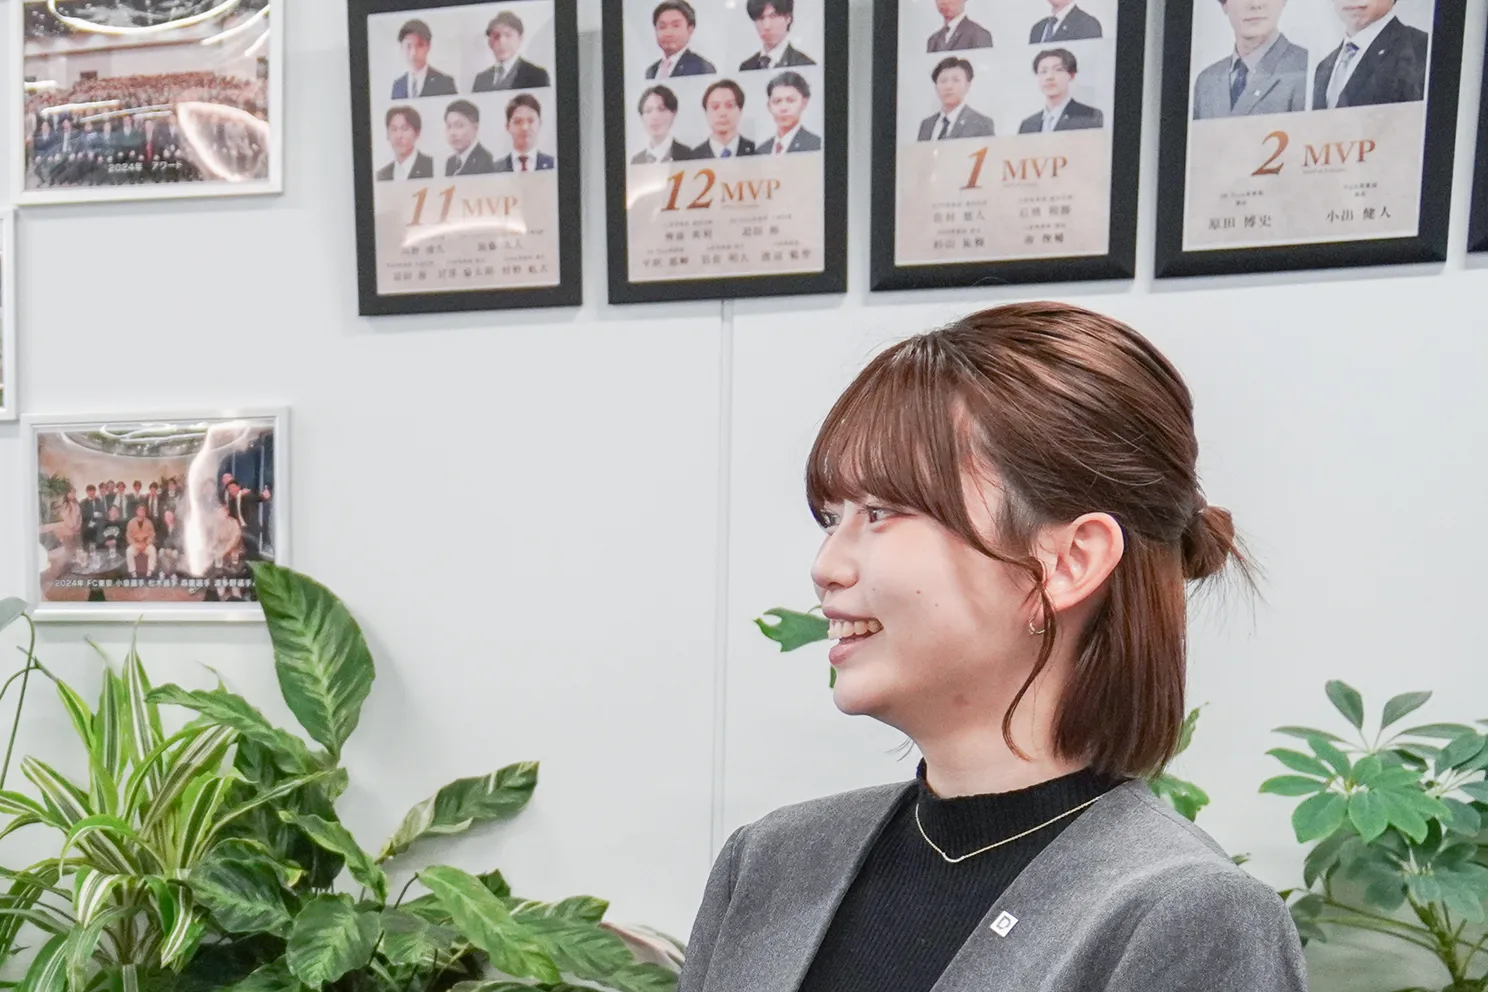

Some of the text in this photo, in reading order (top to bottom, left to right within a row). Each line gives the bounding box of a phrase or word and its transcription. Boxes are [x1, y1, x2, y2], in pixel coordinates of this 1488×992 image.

[960, 146, 1068, 190] 1 MVP
[1251, 131, 1376, 176] 2 MVP
[406, 184, 519, 227] 11 MVP
[661, 168, 781, 212] 12 MVP
